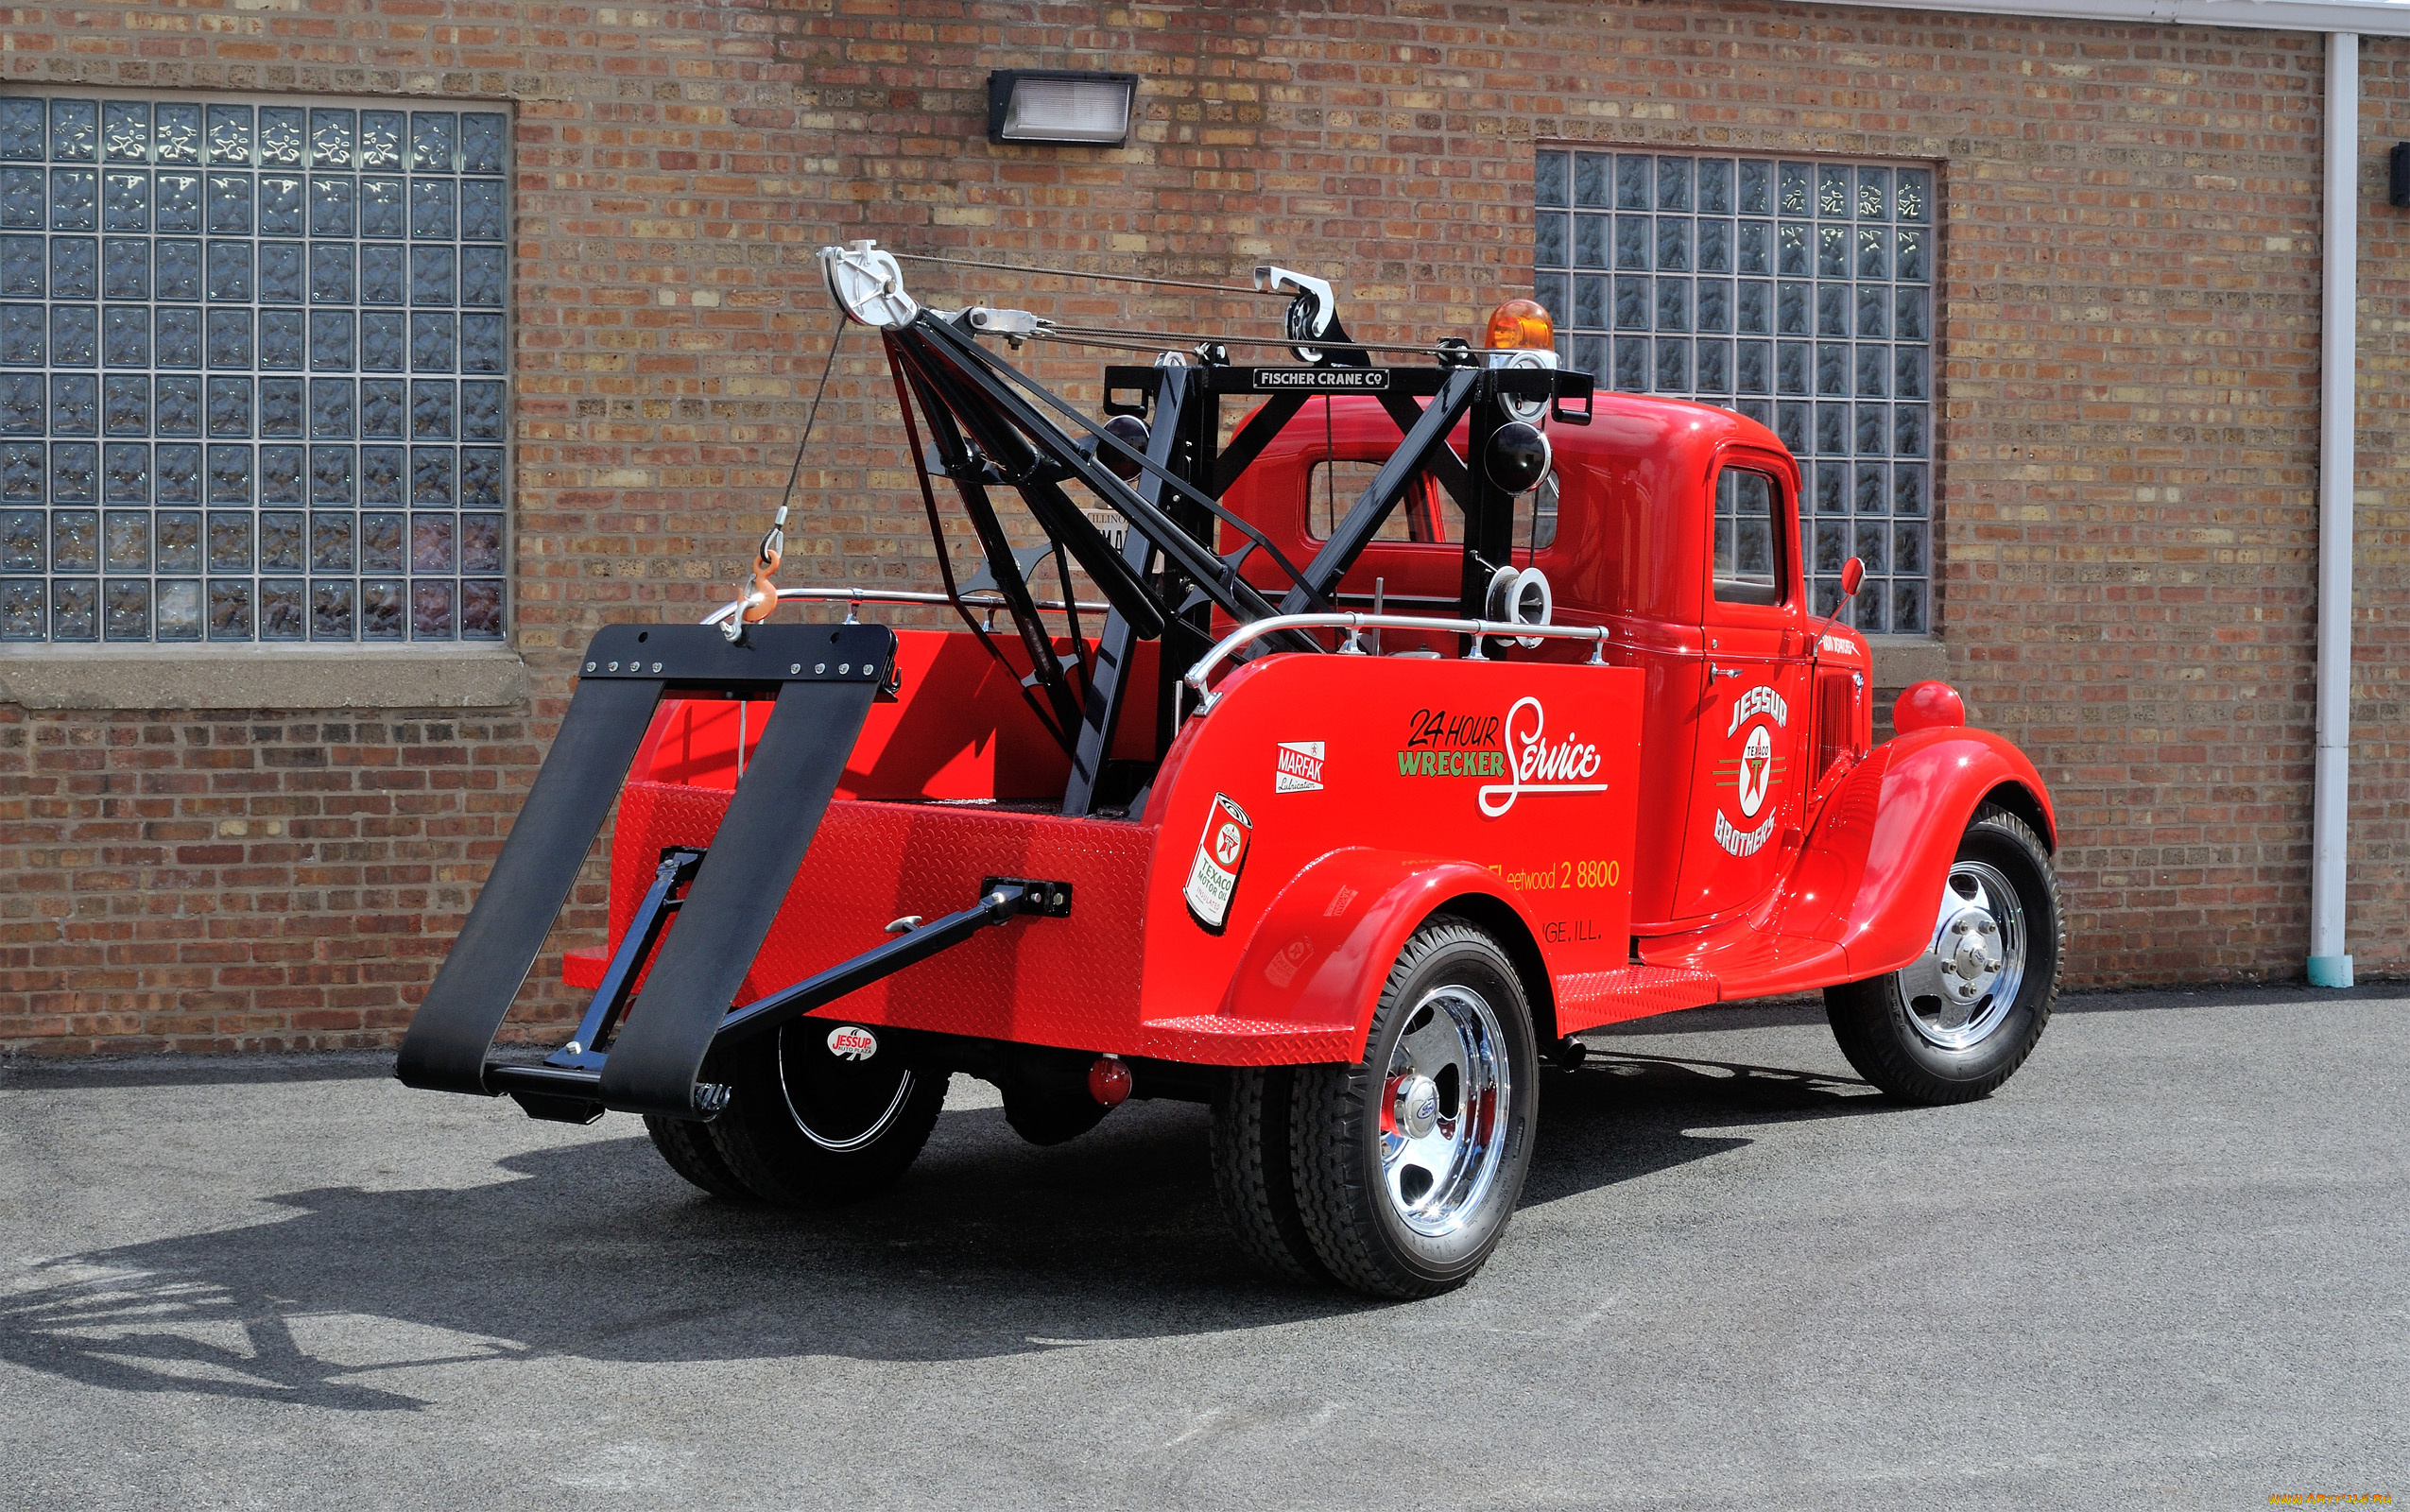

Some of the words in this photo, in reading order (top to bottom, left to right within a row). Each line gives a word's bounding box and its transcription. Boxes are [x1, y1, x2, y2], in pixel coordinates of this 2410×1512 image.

[1261, 371, 1315, 386] FISCHER
[1317, 371, 1363, 386] CRANE
[1093, 514, 1128, 524] ILLINO
[1407, 709, 1446, 747] 24
[1446, 714, 1499, 747] HOUR
[1727, 685, 1788, 740] JESSUP
[1278, 747, 1324, 782] MARFAK
[1398, 750, 1506, 778] WRECKER
[1478, 696, 1609, 817] Service
[1747, 746, 1769, 757] TEXACO
[1713, 805, 1777, 858] BROTHERS
[1197, 870, 1218, 897] MOTOR
[1218, 890, 1228, 901] OIL
[1202, 857, 1231, 891] TEXACO
[1489, 863, 1556, 890] eetwood
[1560, 861, 1572, 888] 2
[1576, 860, 1620, 888] 8800
[1575, 919, 1602, 941] ILL.
[833, 1035, 871, 1049] JESSUP
